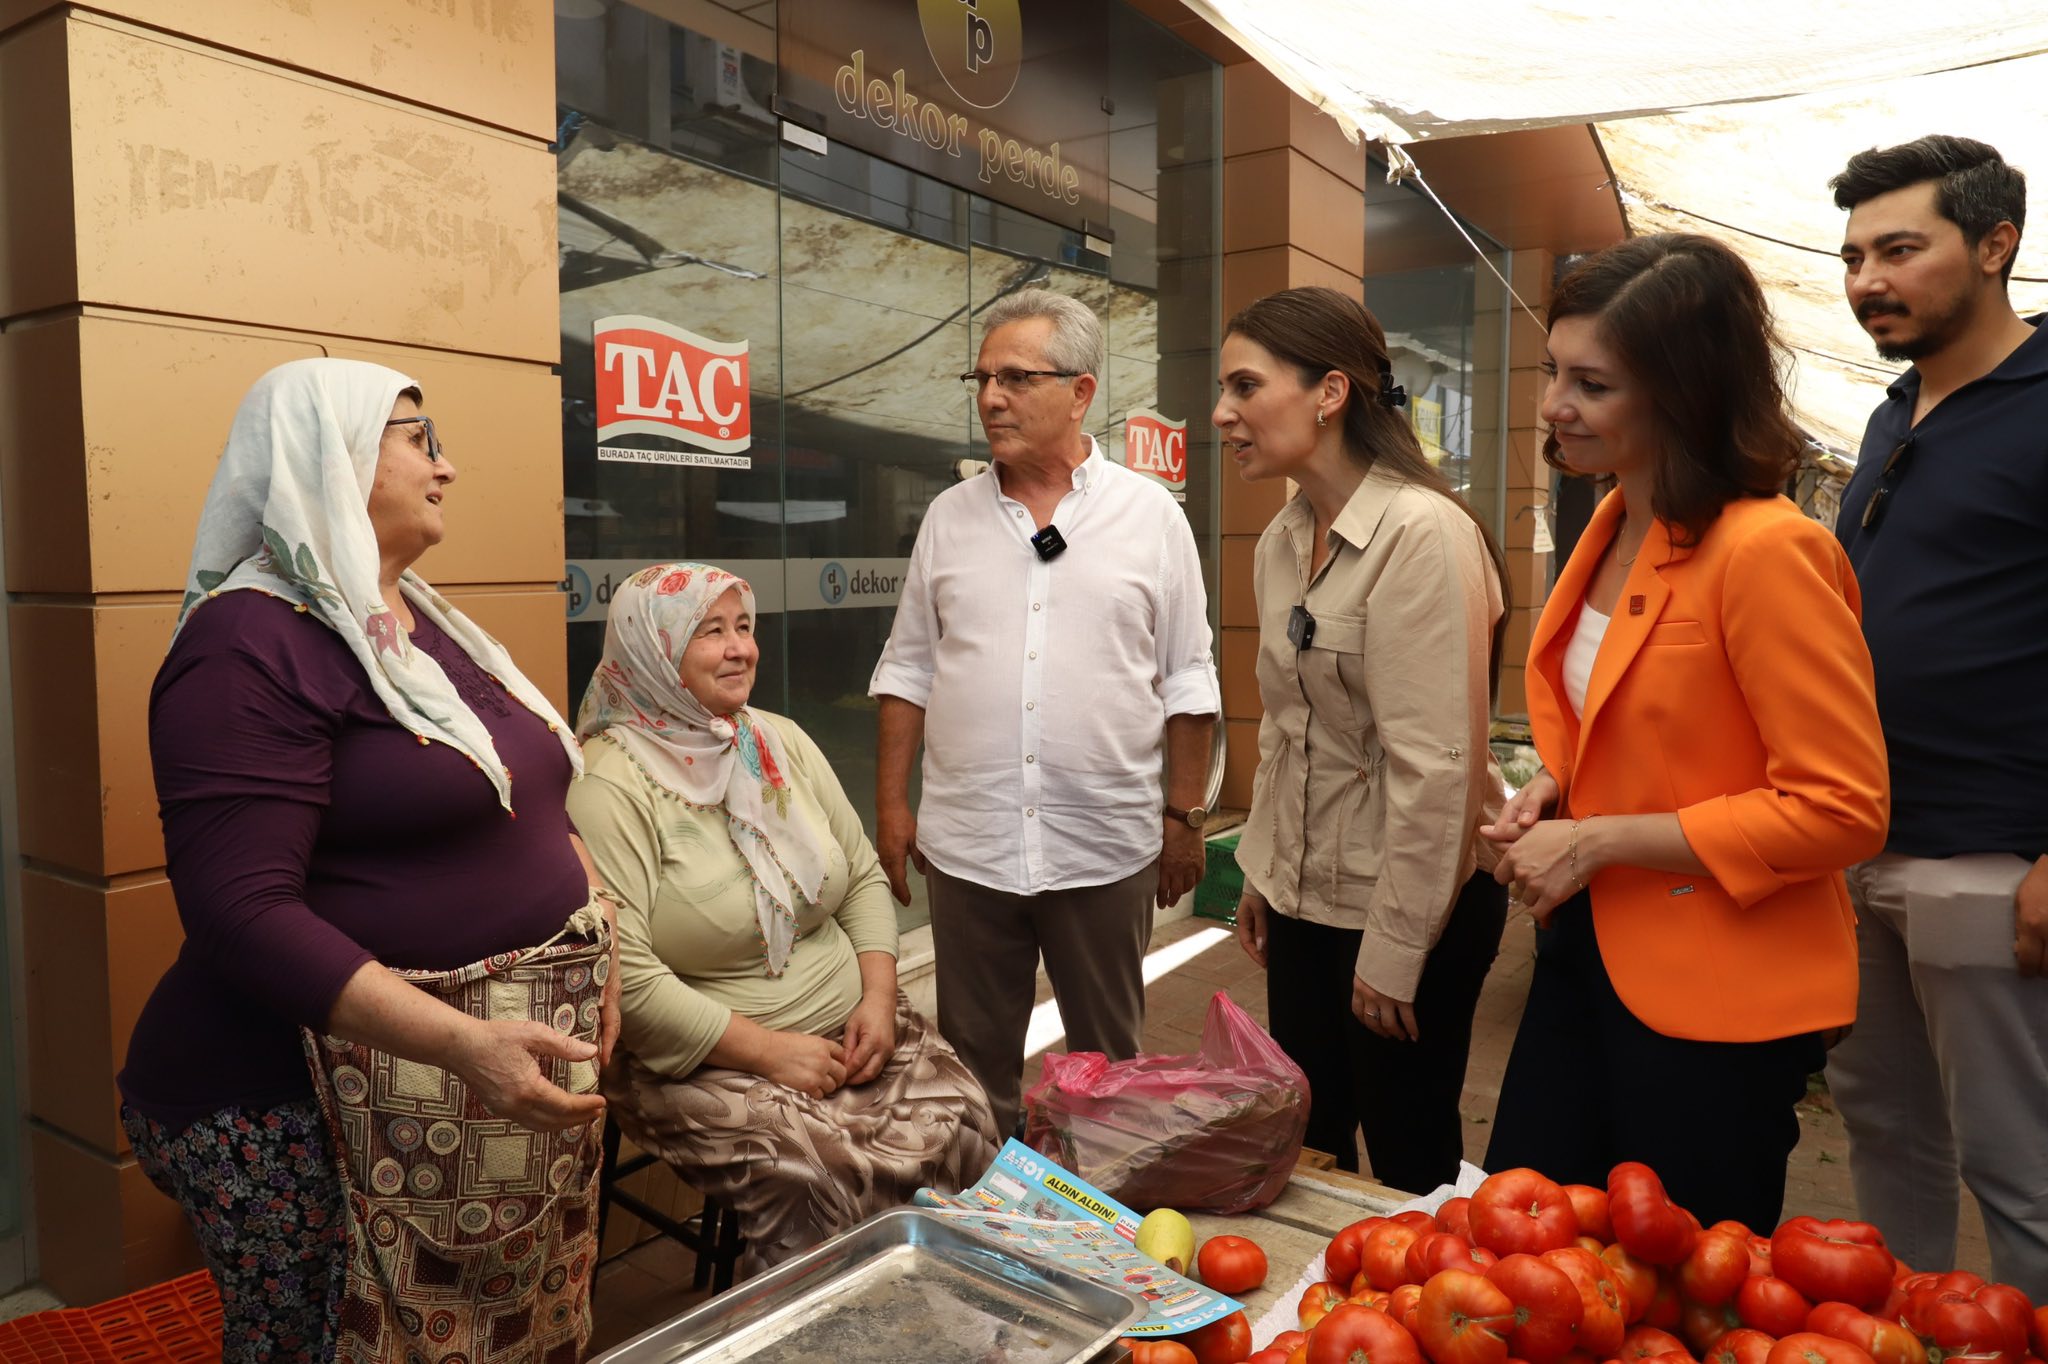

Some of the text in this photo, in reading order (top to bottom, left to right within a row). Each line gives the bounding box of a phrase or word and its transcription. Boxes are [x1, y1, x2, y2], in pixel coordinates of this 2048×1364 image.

[834, 49, 968, 158] dekor
[977, 127, 1080, 206] perde
[600, 449, 750, 467] BURADA TAÇ ÜRÜNLERİ SATILMAKTADIR
[850, 568, 899, 595] dekor
[1046, 1177, 1080, 1200] ALDIN
[1077, 1196, 1116, 1221] ALDIN!
